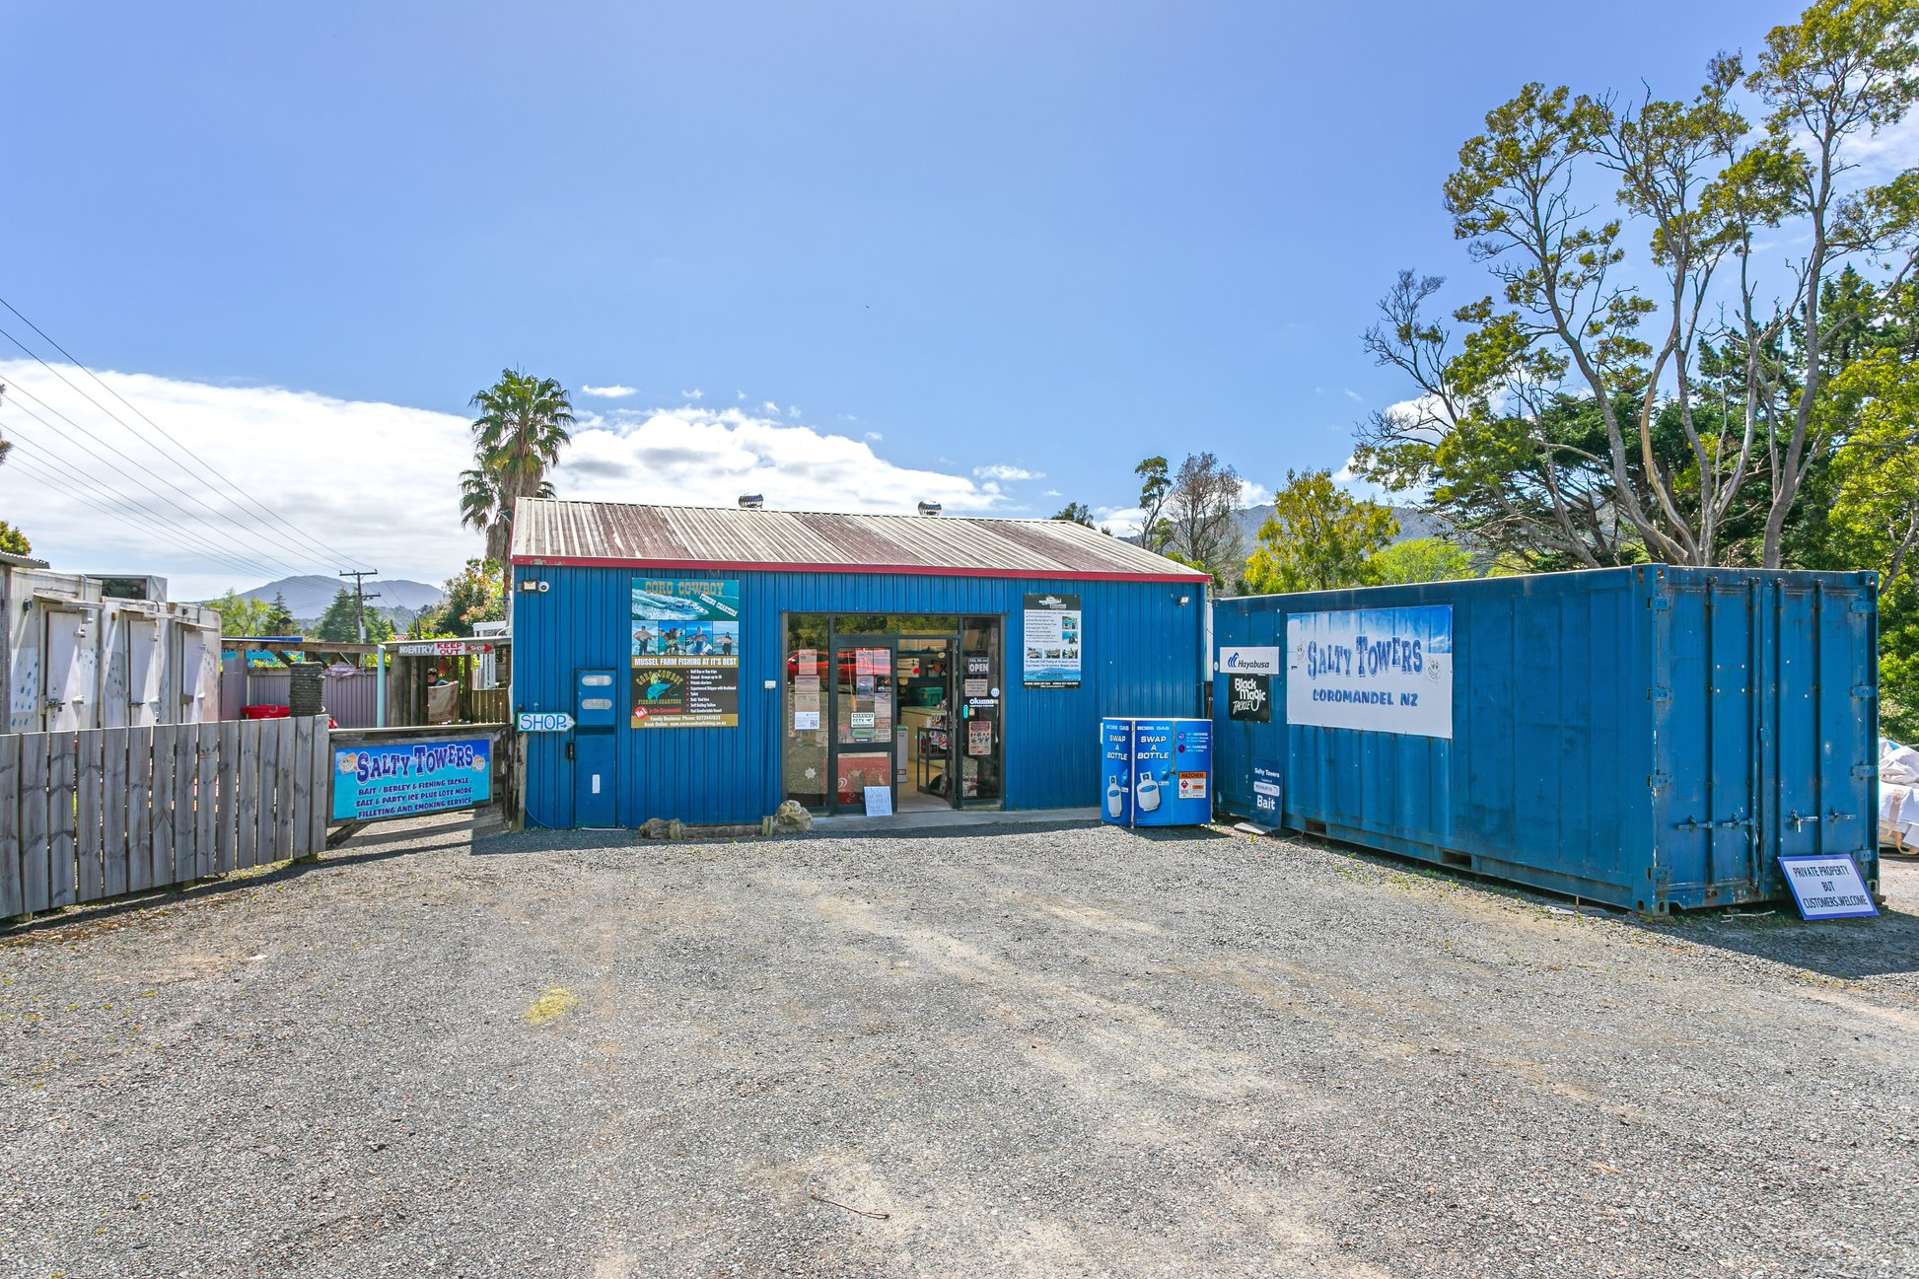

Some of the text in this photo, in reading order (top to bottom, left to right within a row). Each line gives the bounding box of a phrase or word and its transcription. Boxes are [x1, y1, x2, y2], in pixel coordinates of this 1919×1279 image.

[634, 658, 736, 666] MUSSEL FARM FISHING AT IT'S BEST
[1238, 659, 1270, 670] Hayabusa
[1307, 636, 1423, 680] SALTY TOWERS
[969, 663, 989, 672] OPEN
[1234, 678, 1256, 692] Black
[1313, 688, 1418, 706] COROMANDEL NZ
[521, 714, 567, 730] SHOP
[356, 744, 474, 784] SALTY TOWERS
[1107, 752, 1128, 760] BOTTLE
[358, 786, 376, 796] BAIT
[383, 784, 410, 794] BERLEY
[418, 780, 446, 789] FISHING
[356, 800, 373, 808] SALT
[382, 795, 406, 804] PARTY
[408, 793, 419, 801] ICE
[421, 792, 437, 800] PLUS
[438, 789, 454, 797] LOTS
[1257, 794, 1275, 810] Bait
[358, 807, 396, 818] FILLETING
[415, 802, 446, 811] SMOKING
[447, 797, 472, 806] SERVICE
[1792, 865, 1850, 877] PRIVATE PROPERTY
[1821, 881, 1835, 892] BUT
